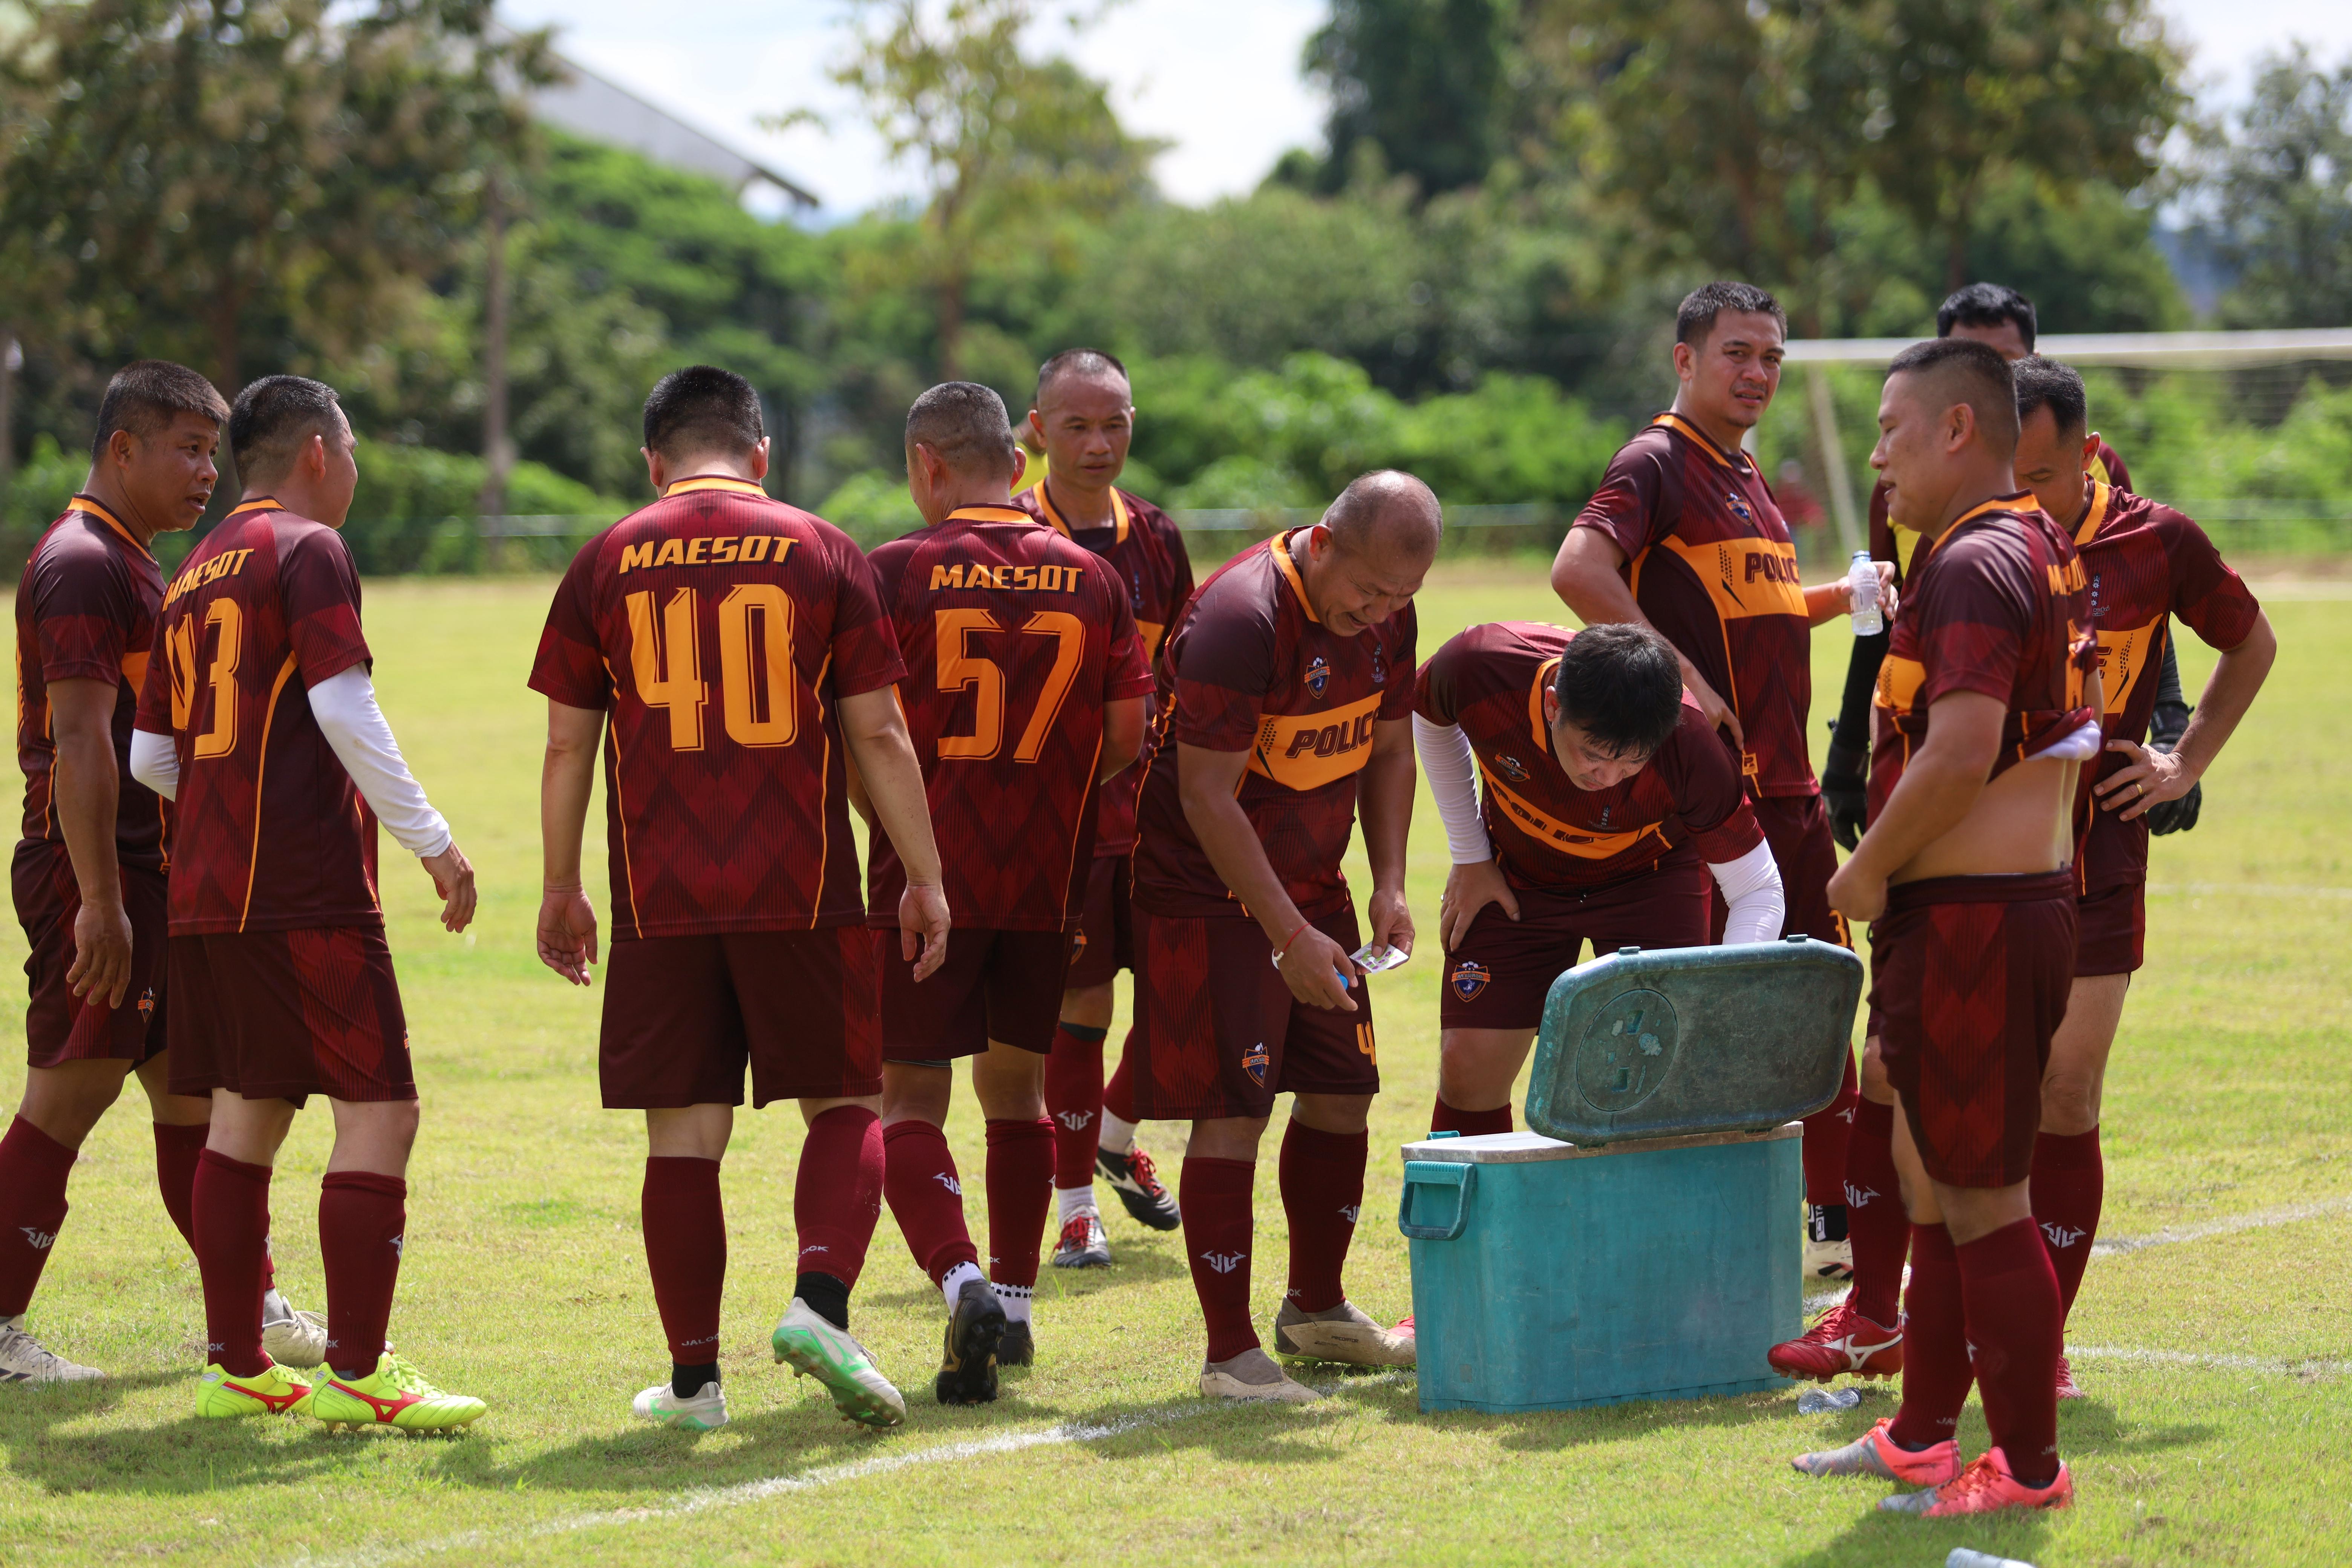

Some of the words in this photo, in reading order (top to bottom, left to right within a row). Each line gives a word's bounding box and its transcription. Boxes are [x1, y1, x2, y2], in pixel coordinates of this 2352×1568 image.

[619, 536, 799, 575] MAESOT
[1745, 553, 1801, 585] POLIC
[162, 548, 254, 612] MAESOT
[929, 564, 1083, 593] MAESOT
[625, 583, 798, 752] 40
[935, 608, 1086, 764] 57
[681, 1332, 719, 1346] JALOC
